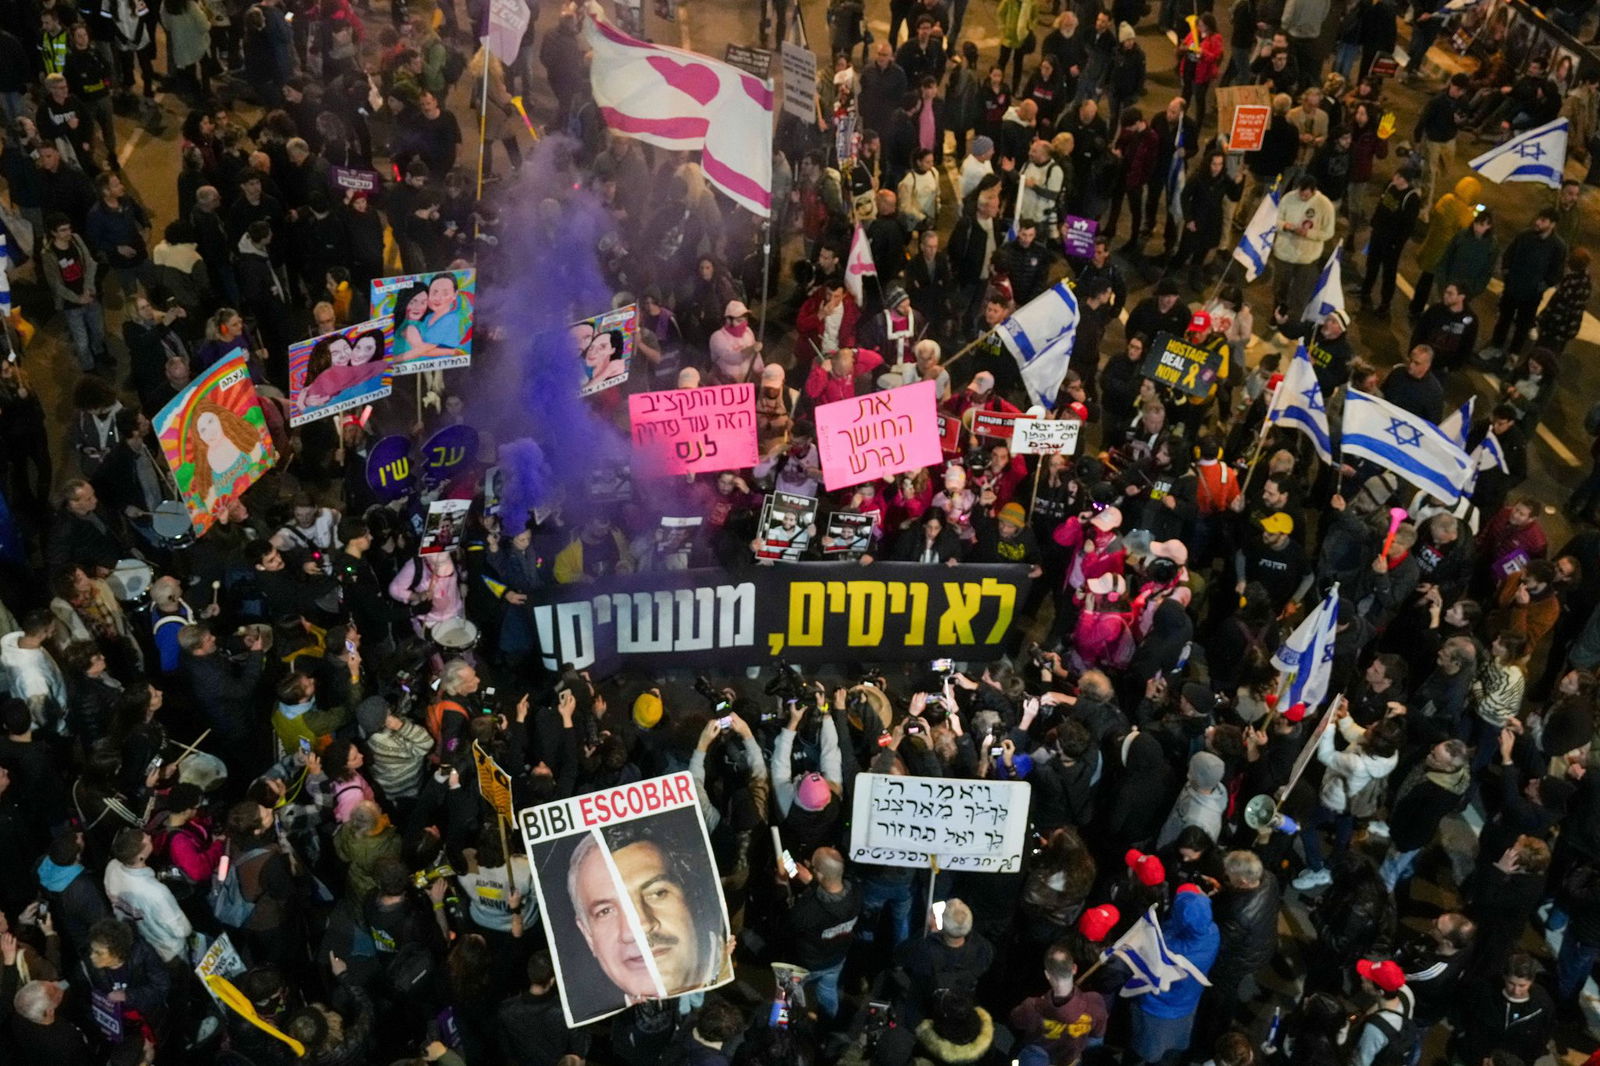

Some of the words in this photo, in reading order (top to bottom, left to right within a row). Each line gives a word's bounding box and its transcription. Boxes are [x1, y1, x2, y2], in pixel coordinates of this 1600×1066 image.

[1160, 350, 1185, 371] DEAL
[1166, 338, 1209, 365] HOSTAGE
[1154, 363, 1181, 384] NOW
[641, 389, 715, 416] התקציב
[721, 385, 750, 407] עם
[853, 392, 892, 423] את
[689, 413, 710, 433] עוד
[717, 409, 751, 431] הזה
[838, 413, 913, 455] החושך
[675, 433, 718, 464] לנס
[849, 443, 905, 475] נגרש
[378, 456, 410, 487] שיו
[533, 582, 756, 672] מעשים!
[768, 580, 929, 656] ניסים,
[937, 578, 1017, 645] לא
[523, 803, 575, 840] BIBI
[579, 775, 694, 827] ESCOBAR
[199, 944, 224, 976] NOW
